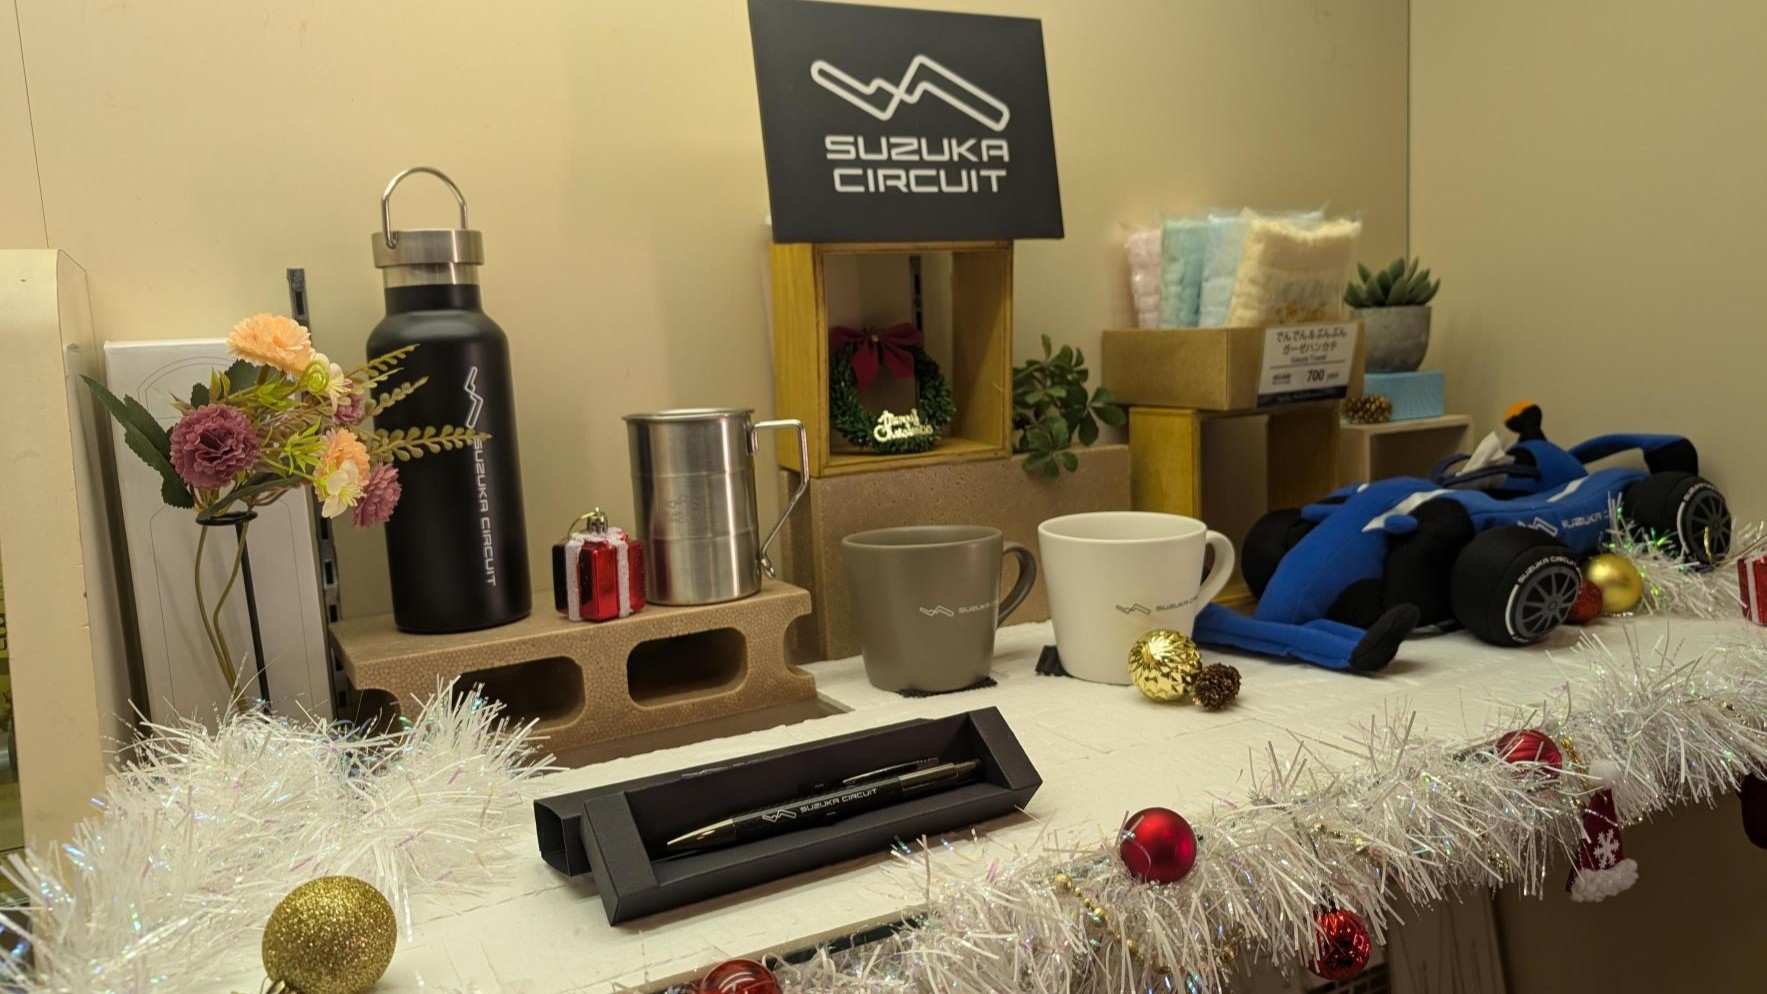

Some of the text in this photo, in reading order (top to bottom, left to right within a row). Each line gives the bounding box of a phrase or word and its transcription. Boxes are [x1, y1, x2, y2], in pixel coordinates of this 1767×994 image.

[824, 134, 1010, 162] SUZUKA
[833, 168, 1007, 192] CIRCUIT
[1282, 341, 1336, 355] ガーゼハンカチ
[1307, 369, 1325, 382] 700
[473, 437, 497, 587] SUZUKA CIRCUIT
[1517, 557, 1549, 585] SUZUKA
[800, 788, 877, 813] SUZUKA CIRCUIT
